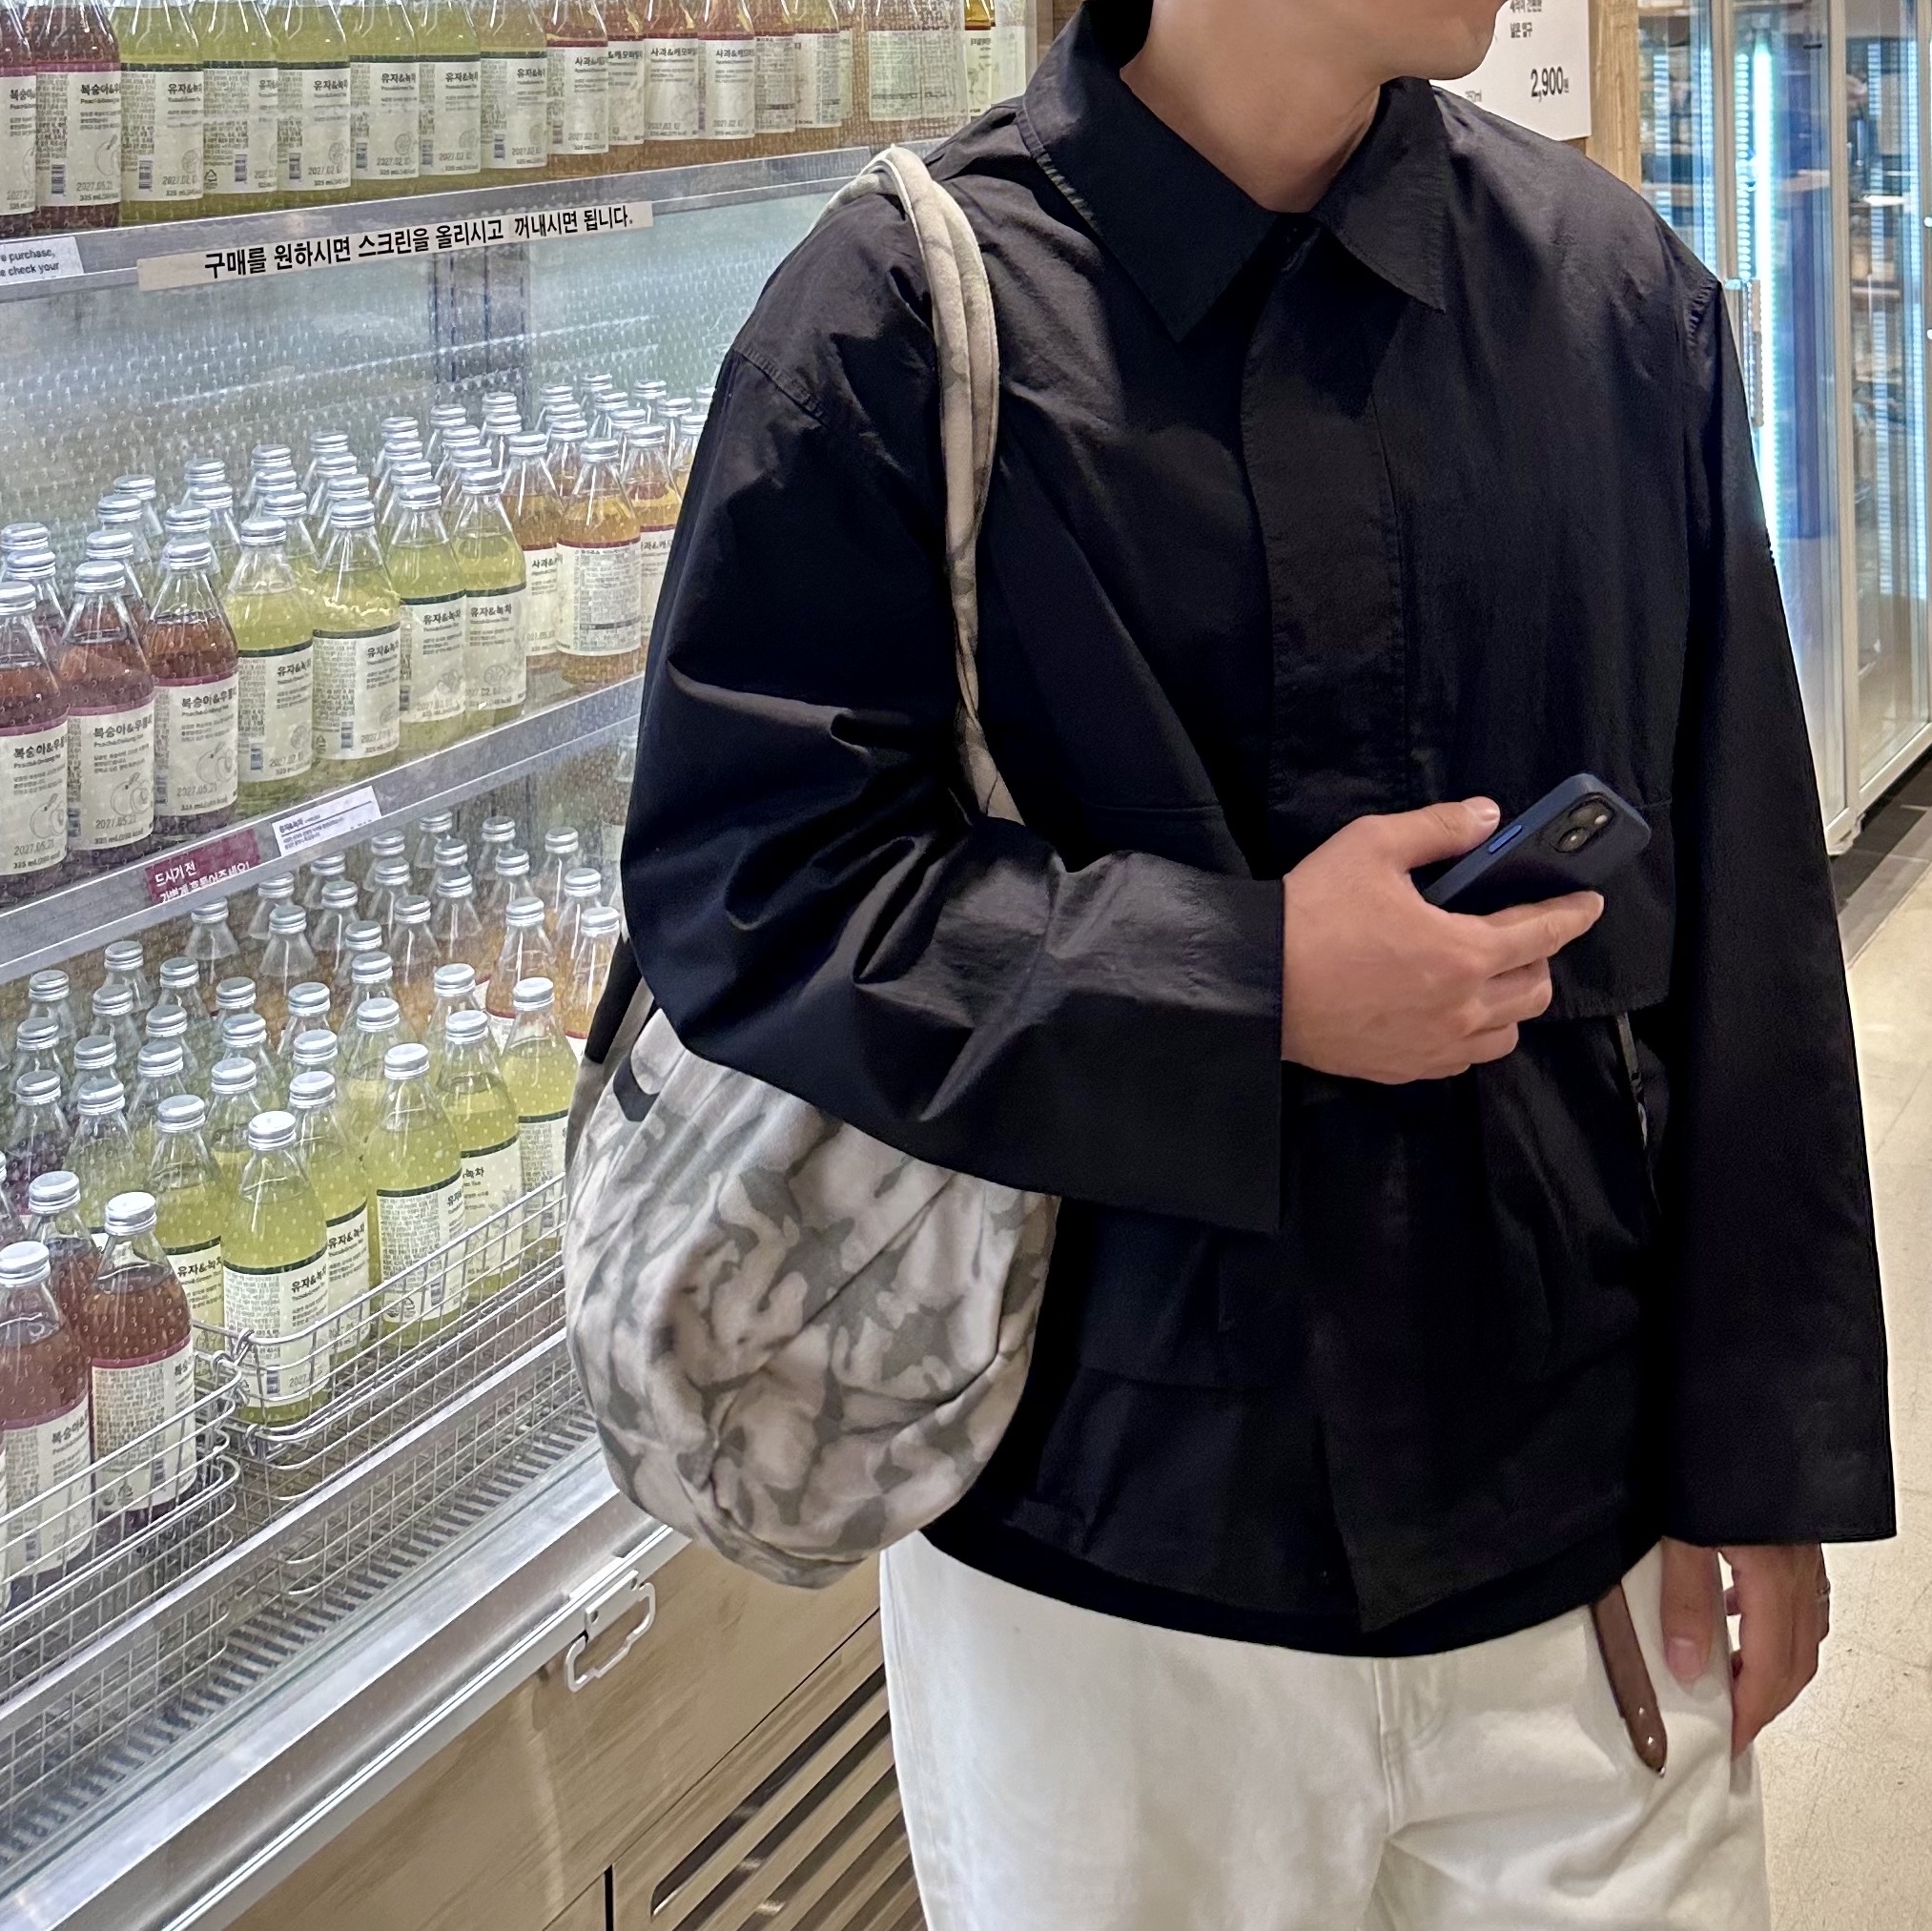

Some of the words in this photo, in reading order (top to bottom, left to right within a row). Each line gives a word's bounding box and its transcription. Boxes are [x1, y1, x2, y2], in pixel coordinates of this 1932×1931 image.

[205, 247, 266, 278] 구매를
[275, 236, 351, 270] 원하시면
[359, 228, 429, 257] 스크린을
[436, 219, 504, 249] 올리시고
[515, 211, 578, 238] 꺼내시면
[585, 205, 633, 231] 됩니다.
[9, 249, 55, 263] purchase,
[9, 265, 36, 276] check
[39, 261, 59, 275] your
[155, 864, 185, 887] 드시기
[185, 860, 197, 876] 전
[462, 1166, 484, 1179] 녹차
